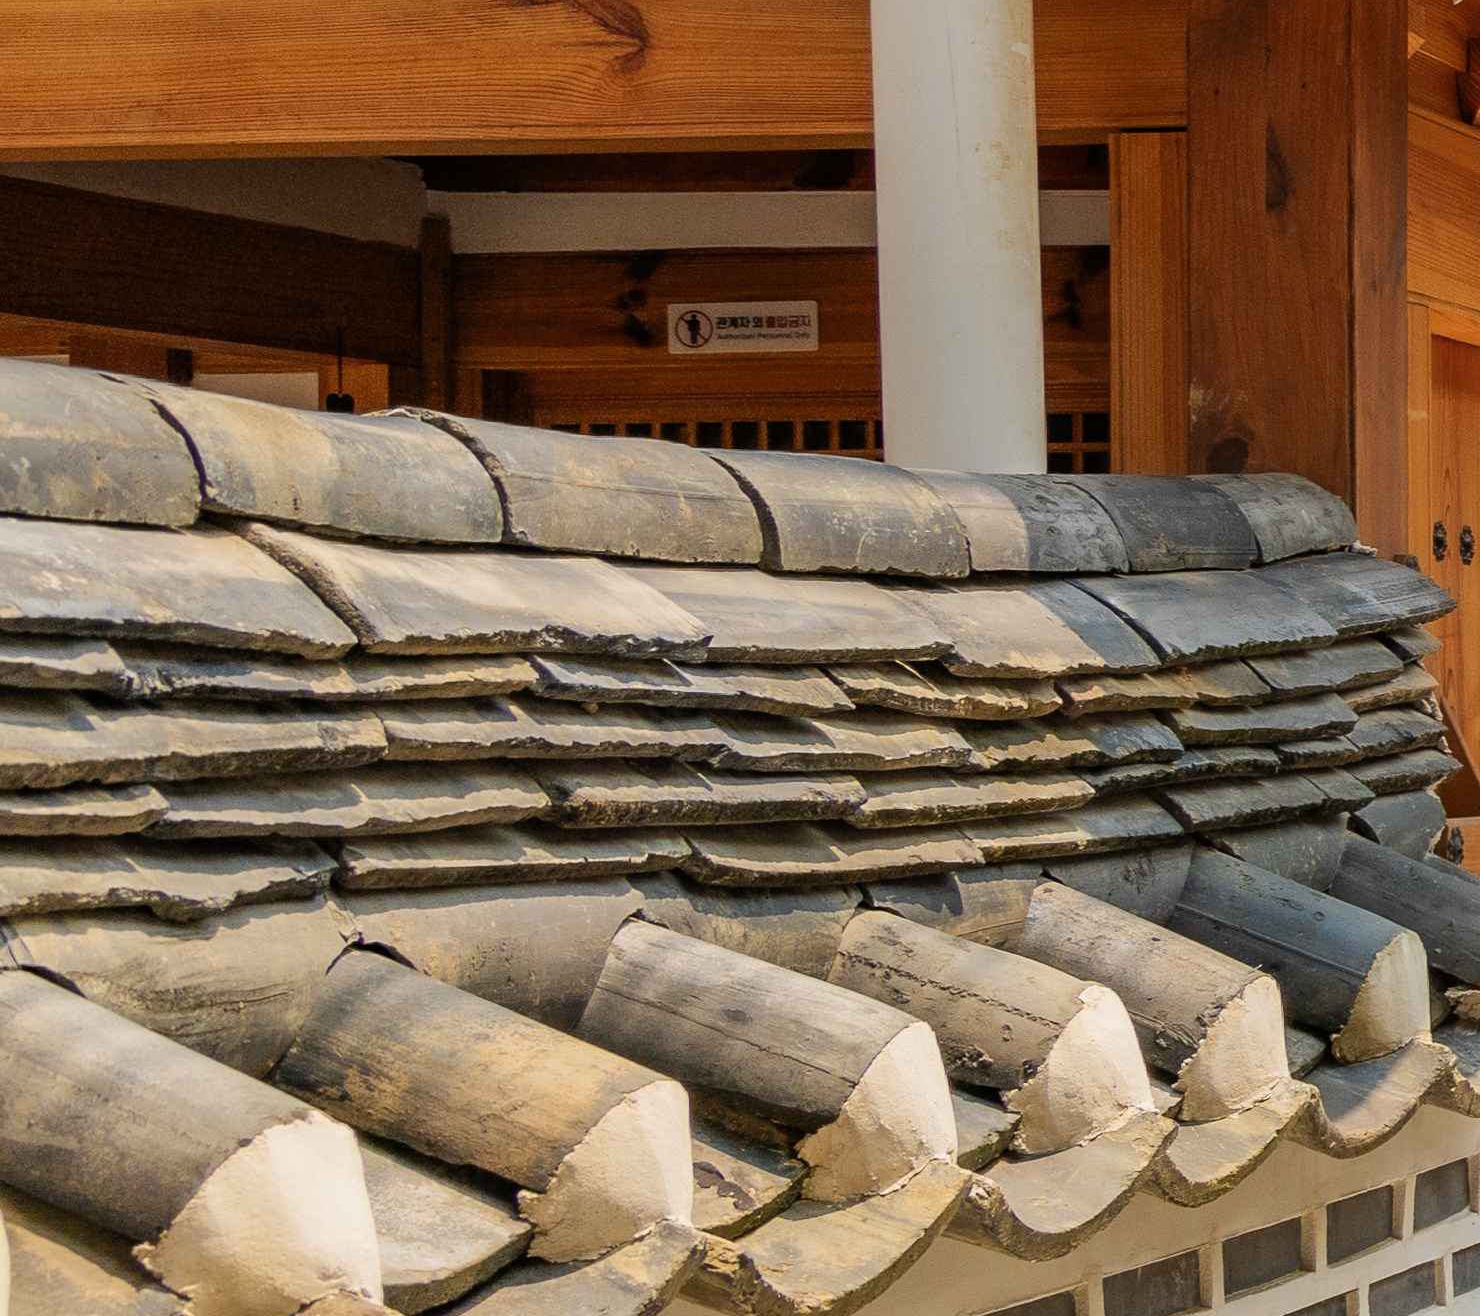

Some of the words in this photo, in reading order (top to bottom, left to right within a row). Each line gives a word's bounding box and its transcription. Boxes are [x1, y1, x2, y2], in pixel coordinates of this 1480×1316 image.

[716, 316, 750, 329] 관계자
[752, 315, 763, 328] 외
[765, 315, 811, 329] 출입금지
